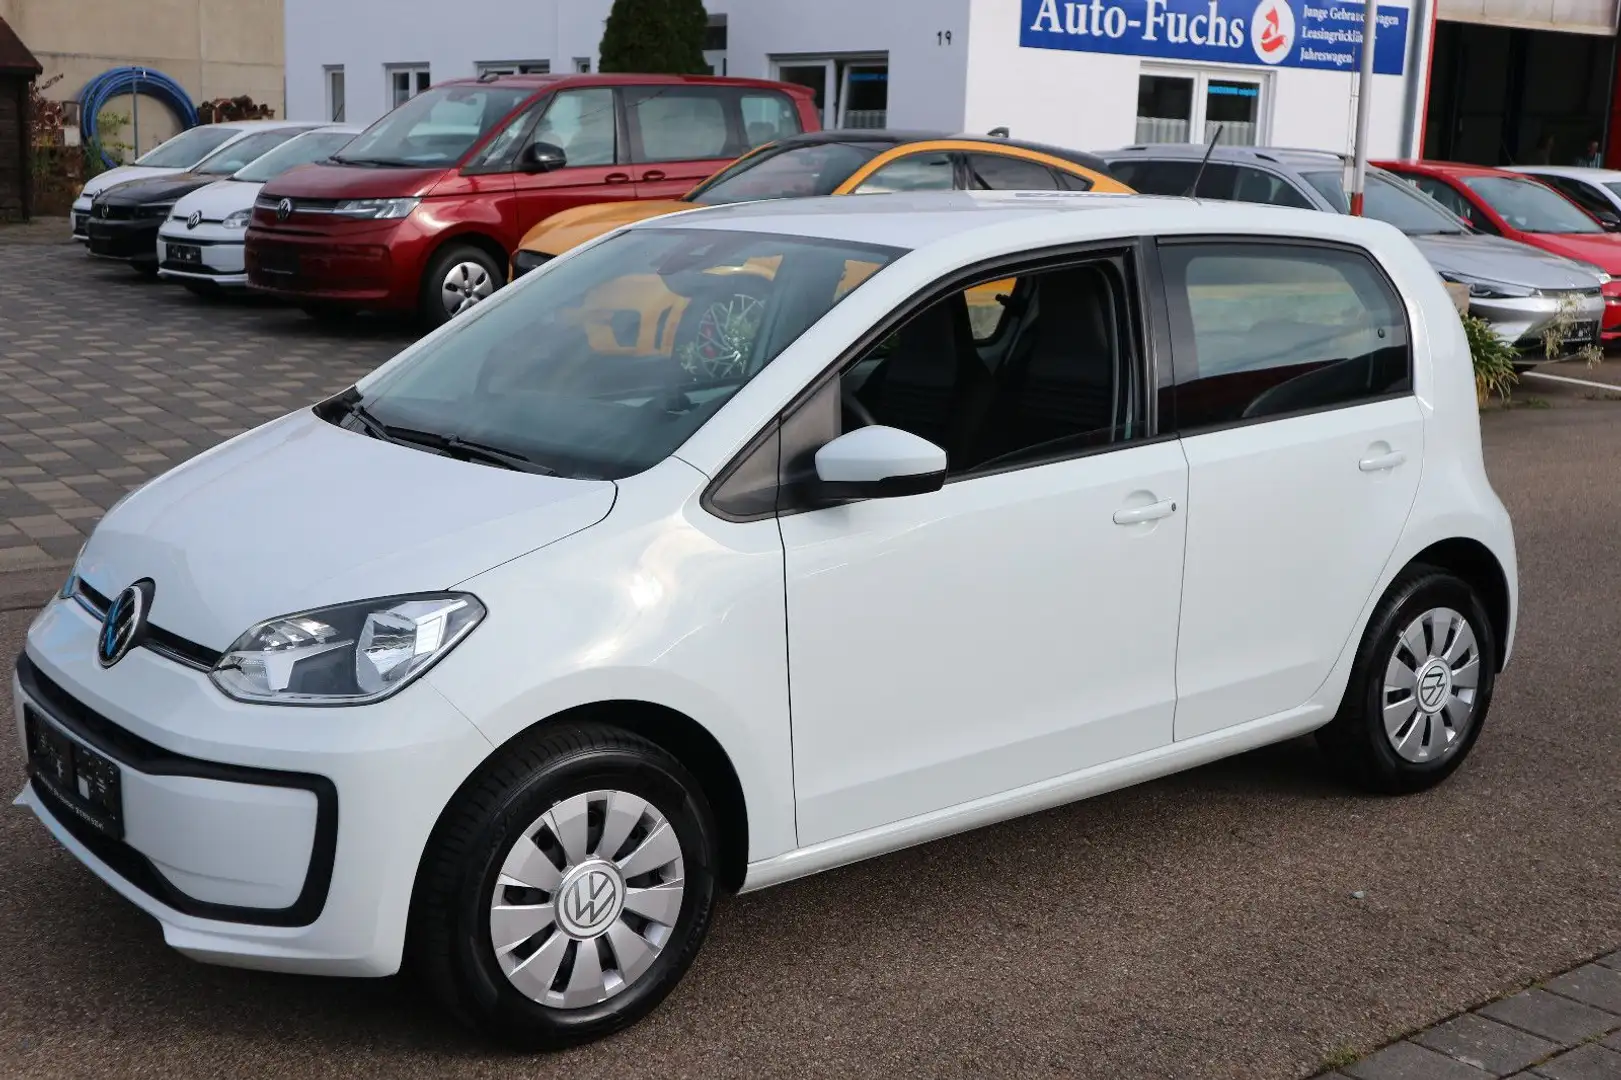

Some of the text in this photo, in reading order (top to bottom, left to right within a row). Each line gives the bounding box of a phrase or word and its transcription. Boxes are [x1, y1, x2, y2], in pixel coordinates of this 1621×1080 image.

[1303, 4, 1328, 22] Junge
[1030, 0, 1245, 48] Auto-Fuchs
[936, 30, 952, 46] 19
[1300, 47, 1352, 66] Jahreswagen
